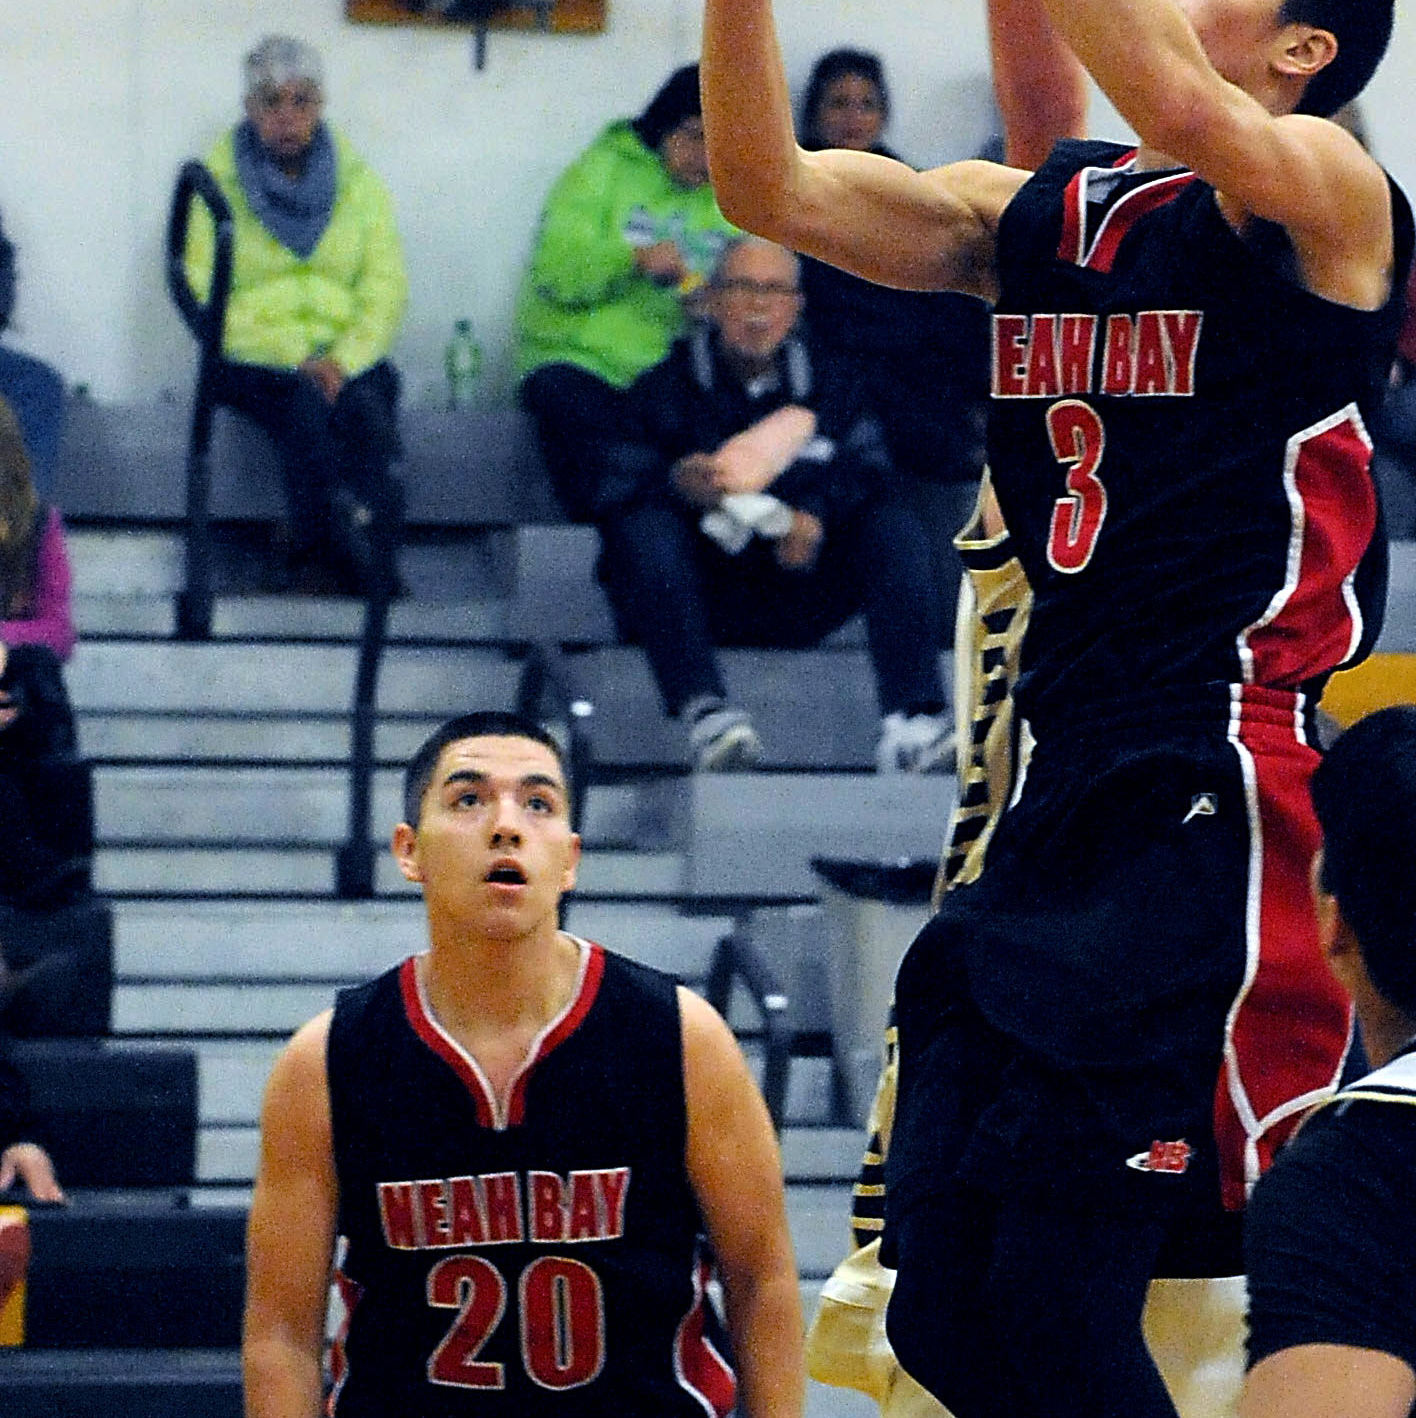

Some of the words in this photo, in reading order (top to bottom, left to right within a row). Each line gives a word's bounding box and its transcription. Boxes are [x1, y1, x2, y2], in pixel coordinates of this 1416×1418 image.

[990, 314, 1098, 399] EAH
[1101, 310, 1204, 397] BAY
[1046, 399, 1107, 574] 3
[376, 1171, 524, 1250] NEAH
[528, 1167, 631, 1243] BAY
[426, 1254, 606, 1391] 20
